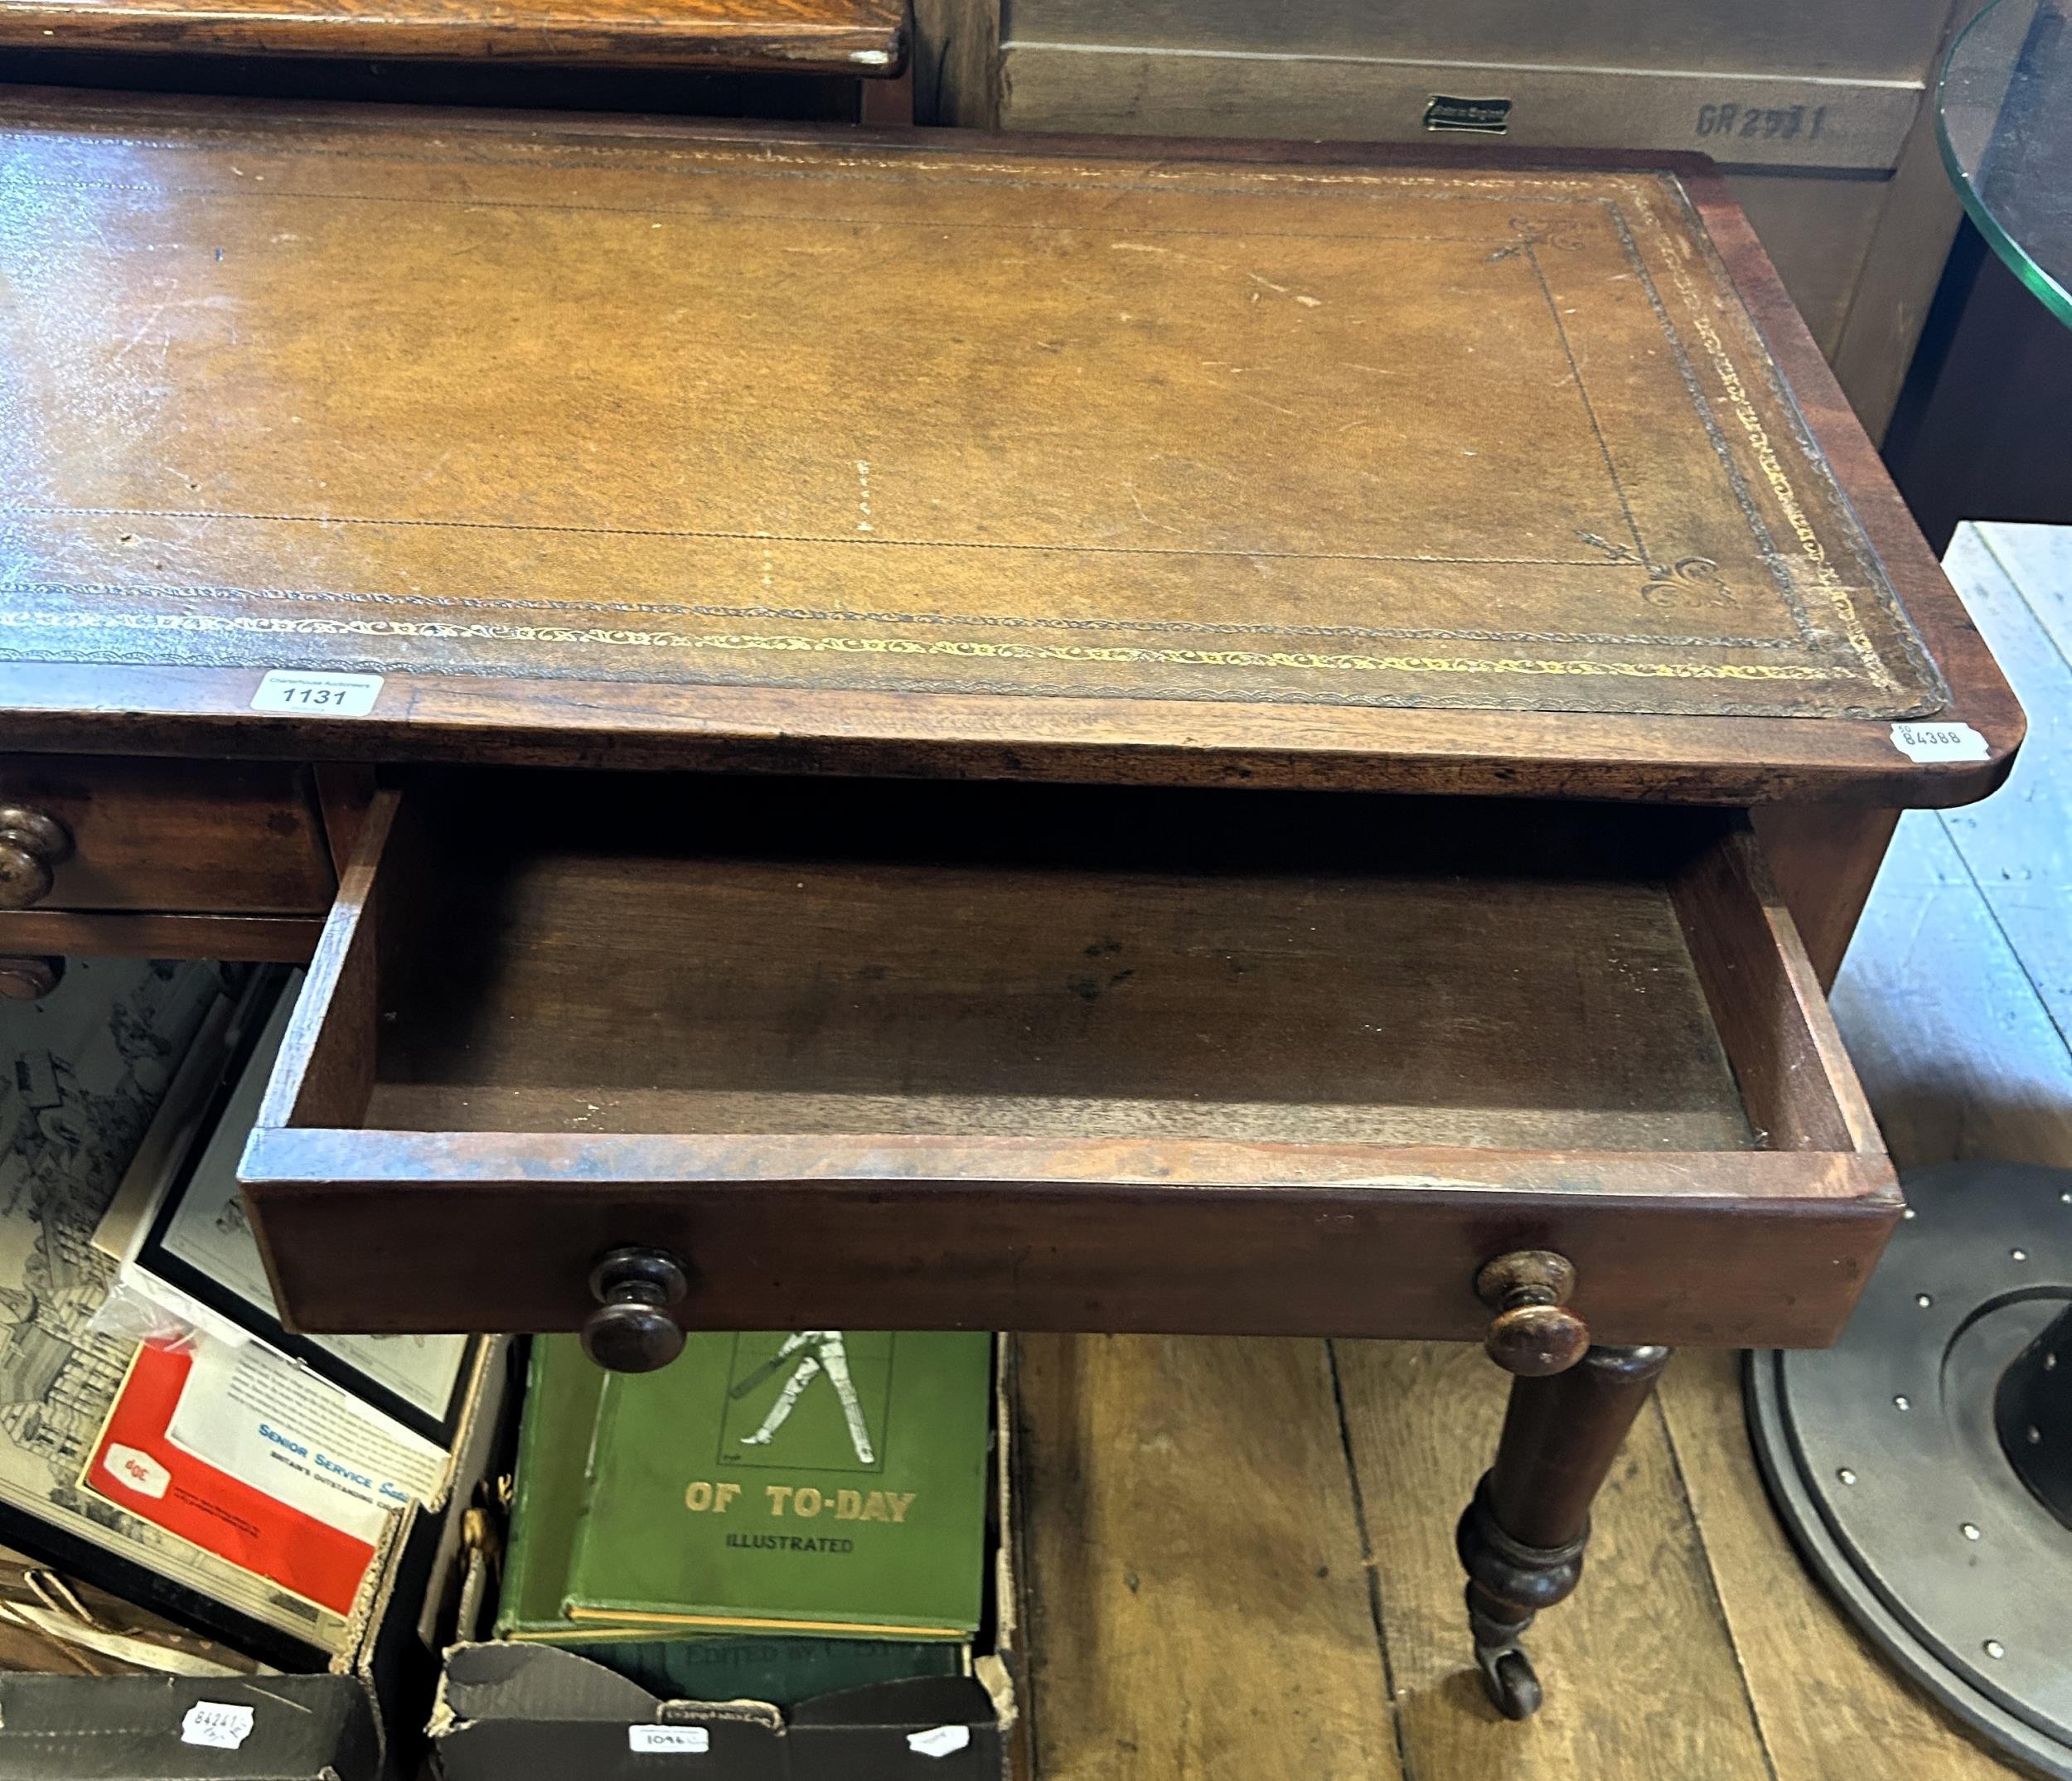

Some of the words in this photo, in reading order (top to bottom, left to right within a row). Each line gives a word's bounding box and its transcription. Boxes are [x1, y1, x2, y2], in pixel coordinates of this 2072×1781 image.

[324, 680, 370, 689] Auctioneers
[283, 688, 346, 705] 1131
[1903, 732, 1961, 745] 84388
[685, 1481, 741, 1513] OF
[766, 1485, 917, 1522] TO-DAY
[726, 1533, 854, 1553] ILLUSTRATED
